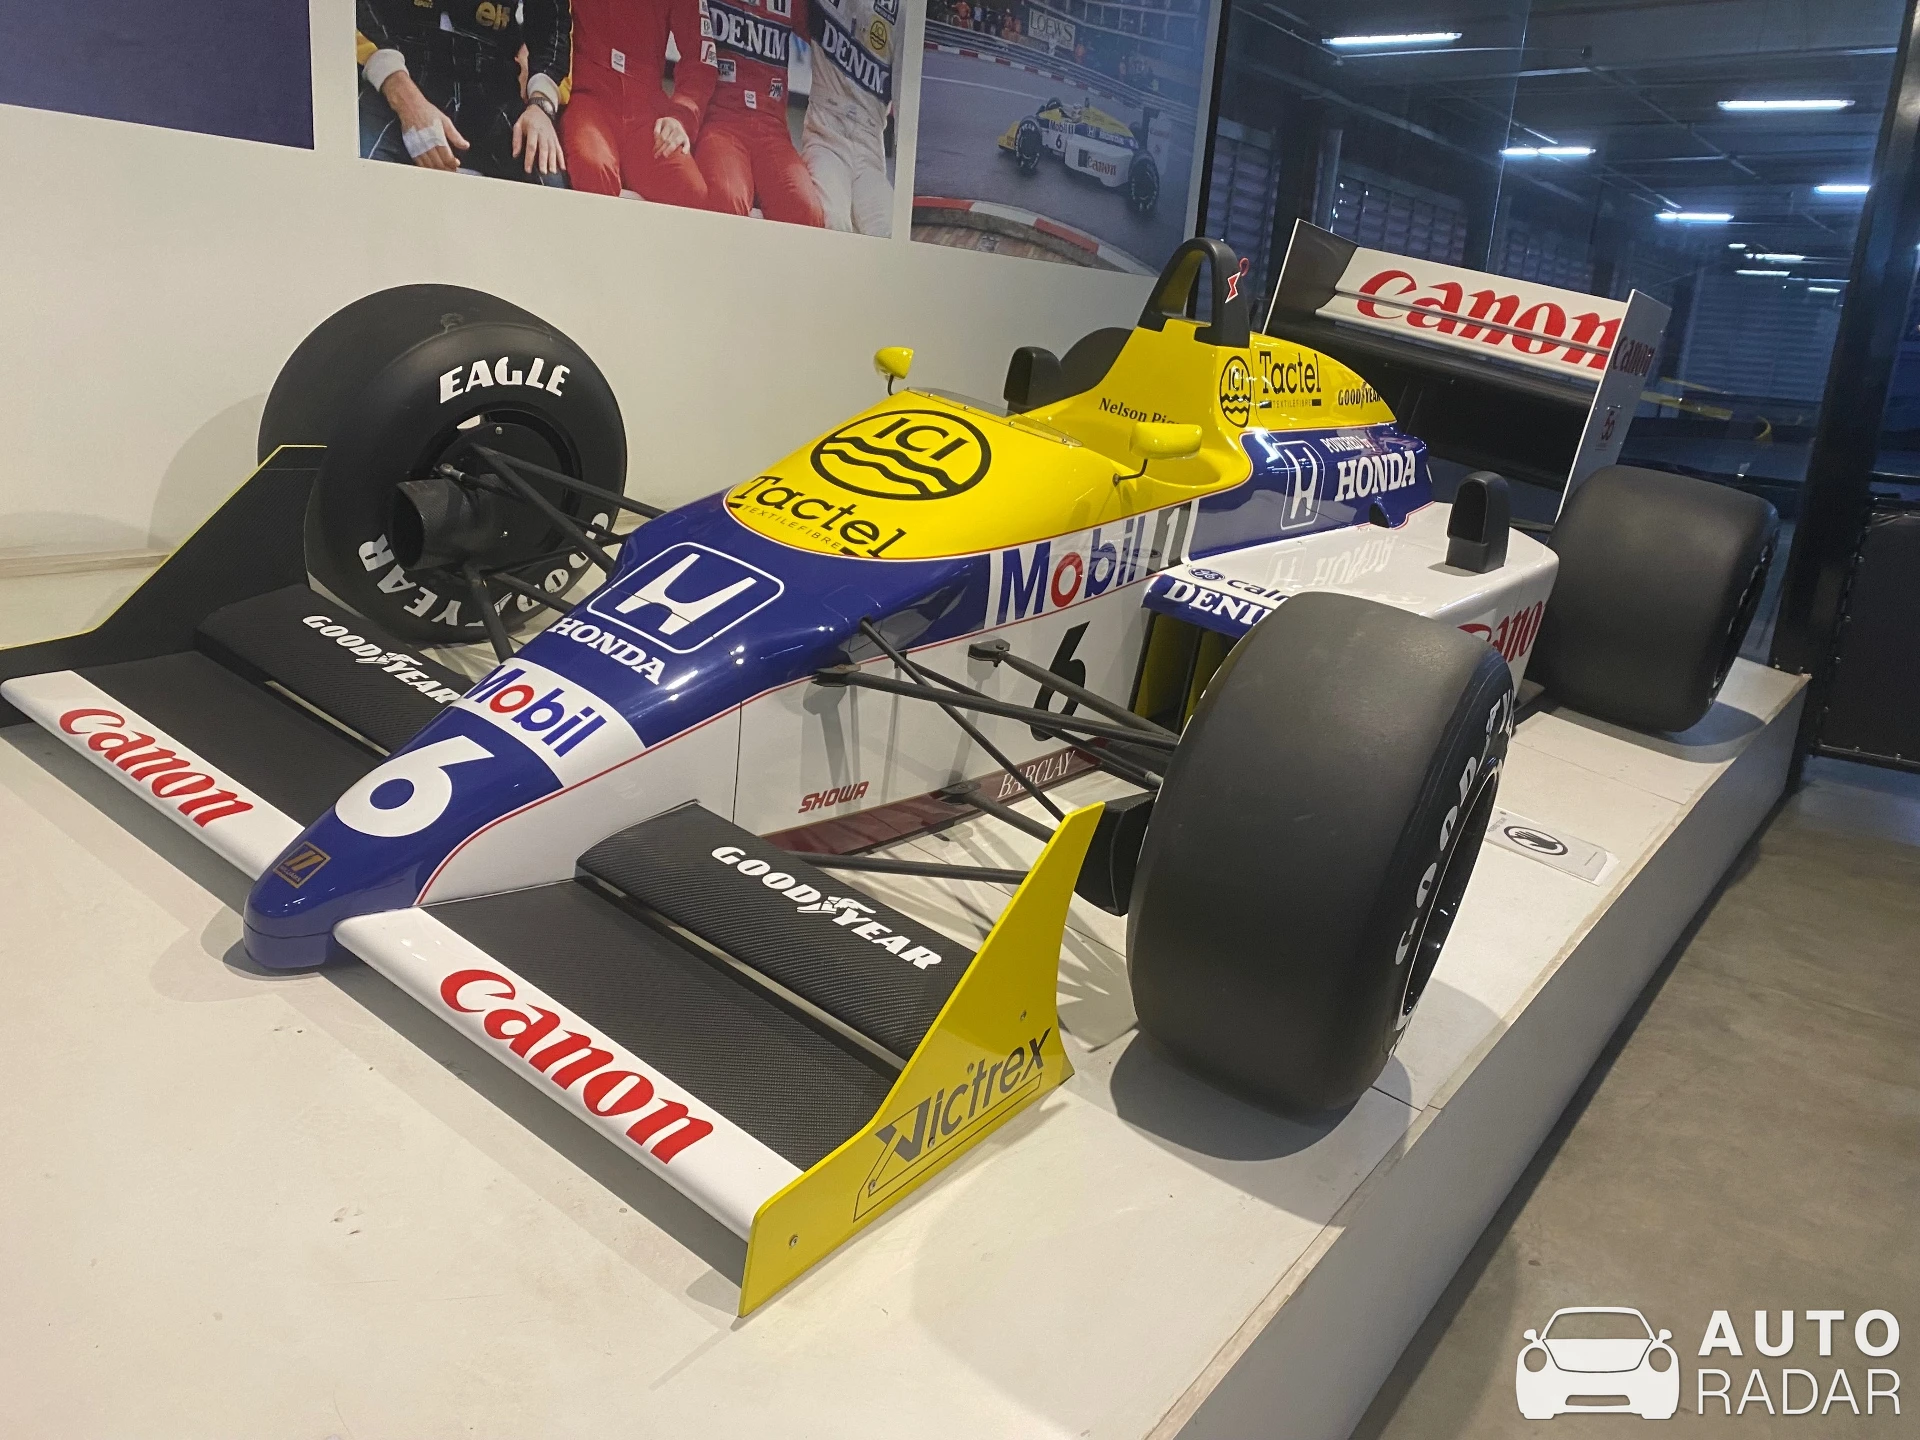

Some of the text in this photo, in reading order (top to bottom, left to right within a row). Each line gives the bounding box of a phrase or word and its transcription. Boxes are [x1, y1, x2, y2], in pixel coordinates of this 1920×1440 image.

[709, 7, 787, 60] DENIM
[1030, 11, 1073, 41] LOEWS
[822, 20, 889, 93] DENIM
[1056, 134, 1062, 148] 6
[1087, 155, 1116, 175] Canon
[1357, 269, 1625, 370] Canon
[440, 356, 570, 403] EAGLE
[1228, 368, 1243, 391] ICI
[1260, 351, 1321, 394] Tactel
[1098, 397, 1147, 422] Nelson
[872, 417, 970, 461] ICI
[1334, 450, 1416, 502] HONDA
[733, 475, 907, 557] Tactel
[742, 505, 842, 550] TEXTILEFIBRE
[996, 507, 1181, 626] Mobil 1
[1163, 580, 1273, 627] DENI
[303, 615, 464, 703] GOODYEAR
[547, 617, 668, 685] HONDA
[1030, 620, 1091, 741] 6
[462, 664, 607, 758] Mobil
[59, 708, 254, 828] Canon
[335, 735, 494, 838] 6
[997, 750, 1076, 799] BARCLAY
[798, 781, 869, 814] SHOWA
[710, 845, 943, 971] GOODYEAR
[440, 968, 713, 1165] Canon
[875, 1027, 1052, 1162] Victrex
